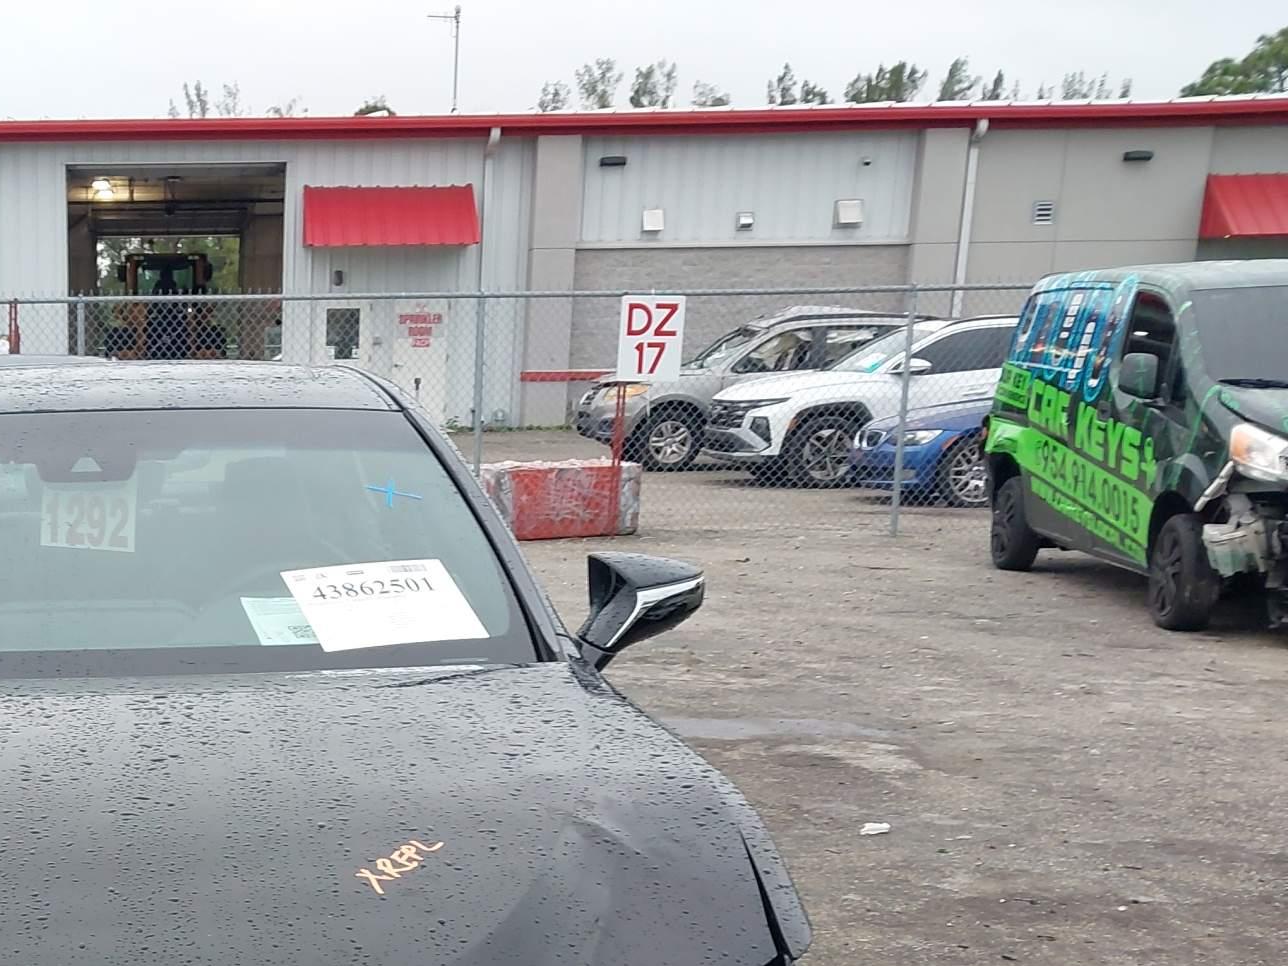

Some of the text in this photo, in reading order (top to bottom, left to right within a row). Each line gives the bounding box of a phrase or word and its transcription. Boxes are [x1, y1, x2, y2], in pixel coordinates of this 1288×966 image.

[626, 303, 680, 336] DZ
[634, 341, 666, 375] 17
[1074, 401, 1142, 482] KEYS
[45, 494, 130, 548] 1292
[313, 577, 436, 600] 43862501
